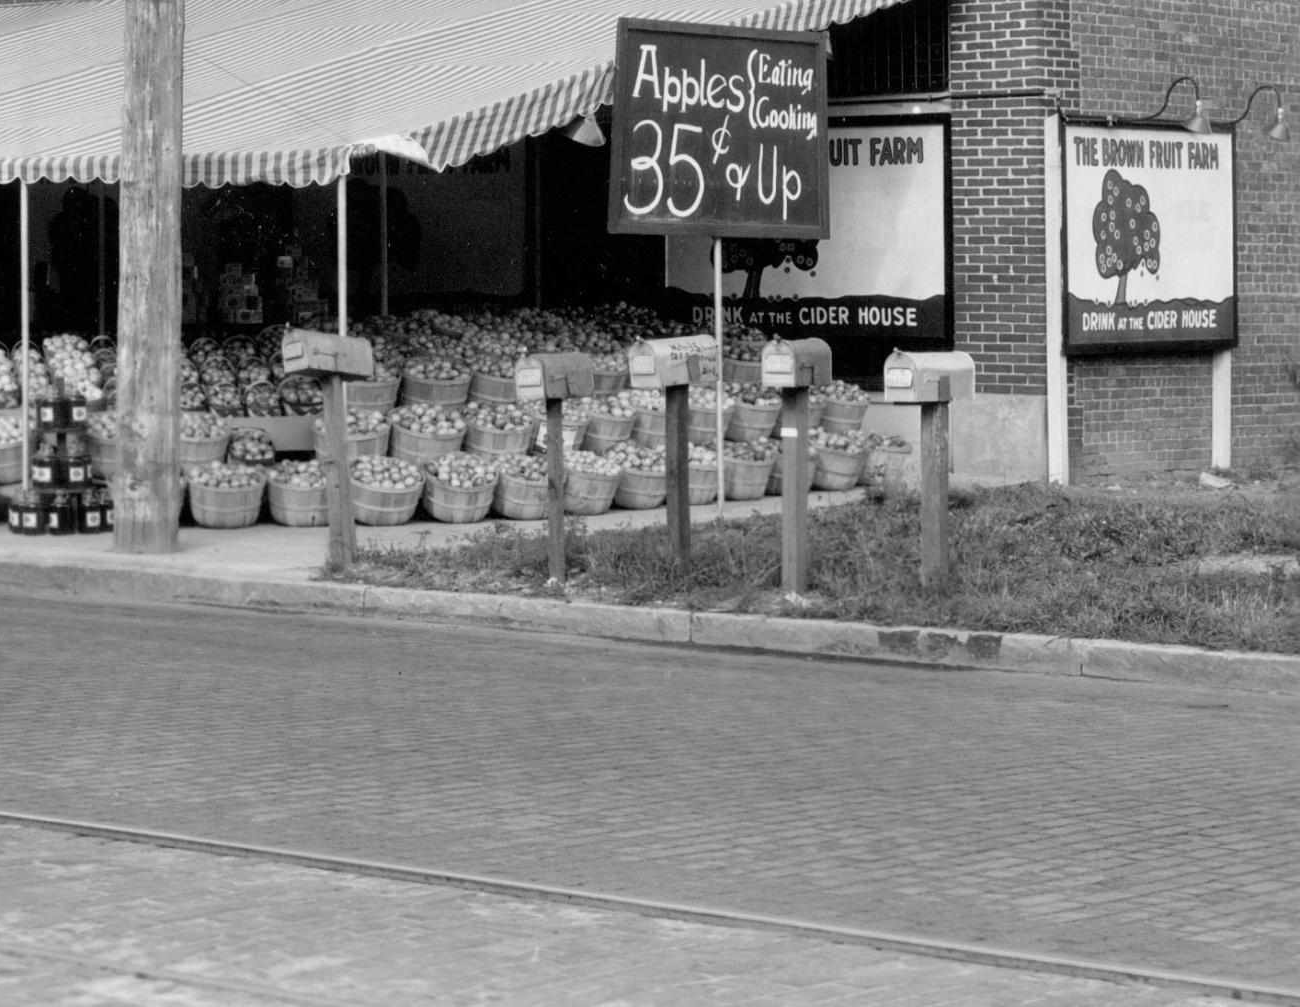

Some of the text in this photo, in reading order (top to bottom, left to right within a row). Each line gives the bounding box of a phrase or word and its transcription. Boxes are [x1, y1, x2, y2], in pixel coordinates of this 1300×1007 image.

[632, 44, 745, 114] Apples
[758, 53, 814, 95] Eating
[755, 96, 818, 141] Cooking
[829, 136, 924, 167] UIT FARM
[1073, 136, 1220, 170] THE BROWN FRUIT FARM
[757, 143, 802, 221] Up
[691, 305, 918, 327] DRNK AT THE CIDER HOUSE
[1081, 308, 1217, 331] DRINK AT THE CIDER HOUSE
